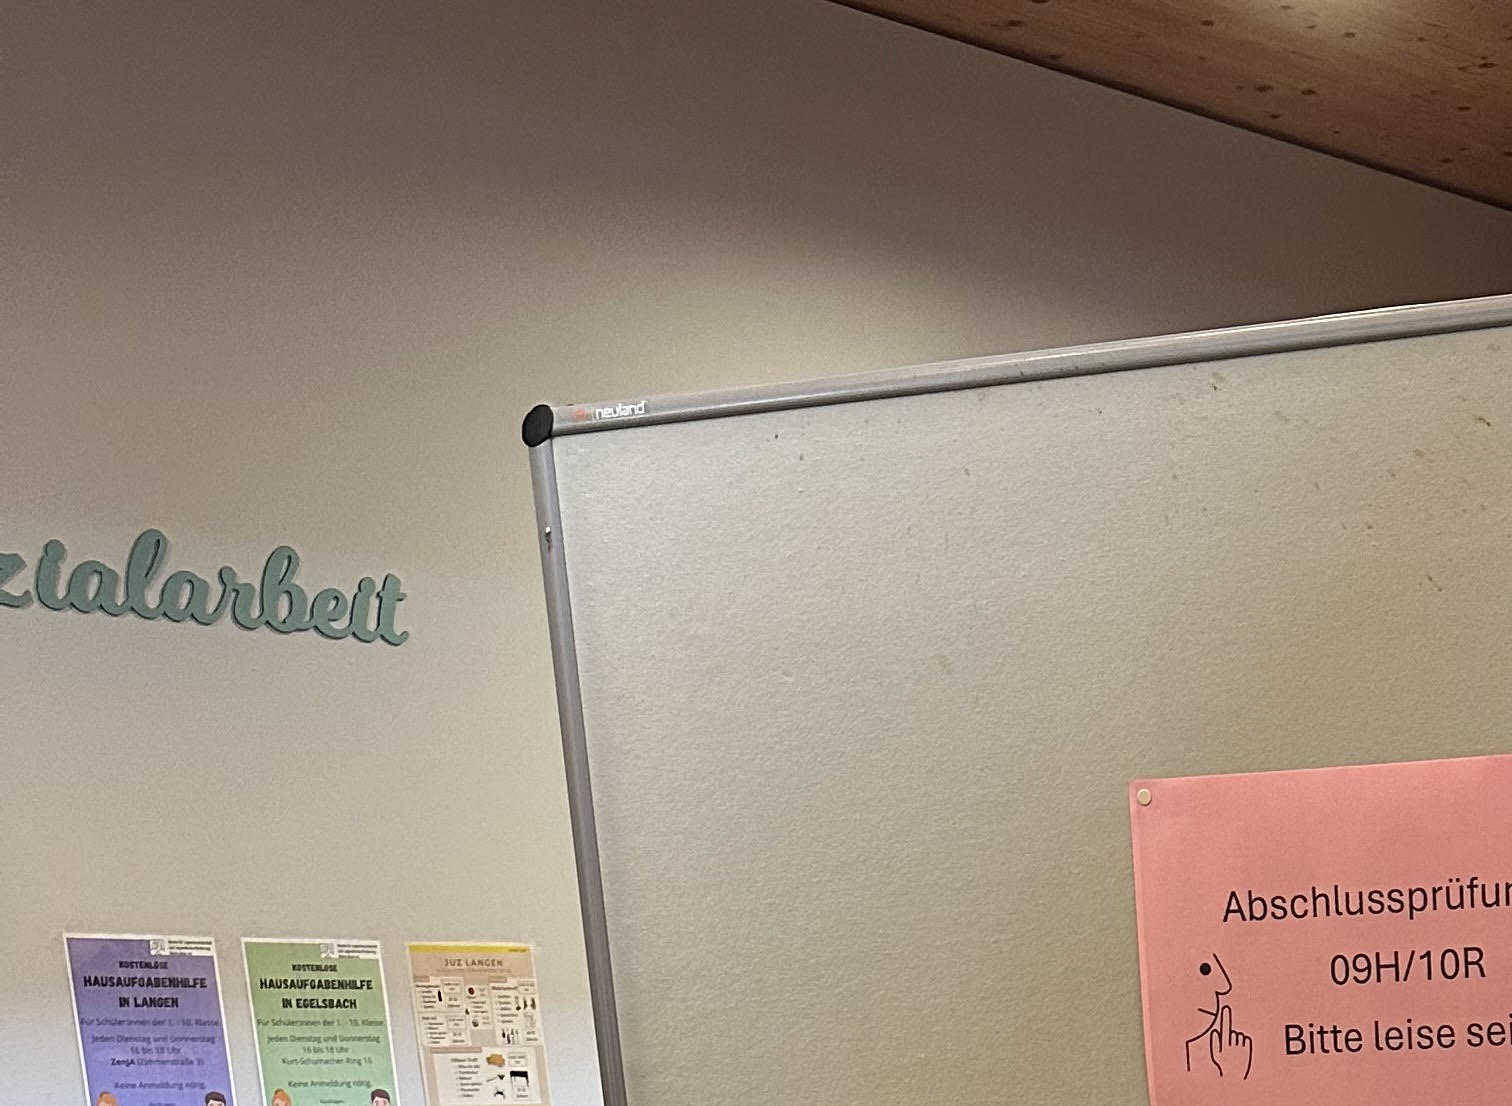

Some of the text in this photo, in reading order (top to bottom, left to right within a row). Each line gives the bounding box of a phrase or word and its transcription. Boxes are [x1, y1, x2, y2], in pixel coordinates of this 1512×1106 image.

[594, 401, 646, 420] neuland
[118, 960, 168, 970] KOSTENLOSE
[444, 958, 503, 967] JUZ LANGEN
[1330, 946, 1486, 986] 09H/10R
[292, 964, 338, 973] KOSTENLOSE
[83, 975, 207, 989] HAUSAUFGABENHILFE
[259, 977, 374, 990] HAUSAUFGABENHILFE
[119, 996, 179, 1009] IN LANGEN
[282, 998, 357, 1009] IN EGELSBACH
[152, 1035, 168, 1044] und
[289, 1034, 322, 1045] Dienstag
[323, 1035, 338, 1044] und
[339, 1034, 381, 1045] Donnerstag
[1284, 1022, 1363, 1056] Bitte
[1374, 1018, 1456, 1051] leise
[167, 1046, 181, 1055] Uhr
[336, 1046, 349, 1055] Uhr
[138, 1081, 184, 1091] Anmeldung
[288, 1080, 309, 1089] Keine
[310, 1079, 352, 1090] Anmeldung
